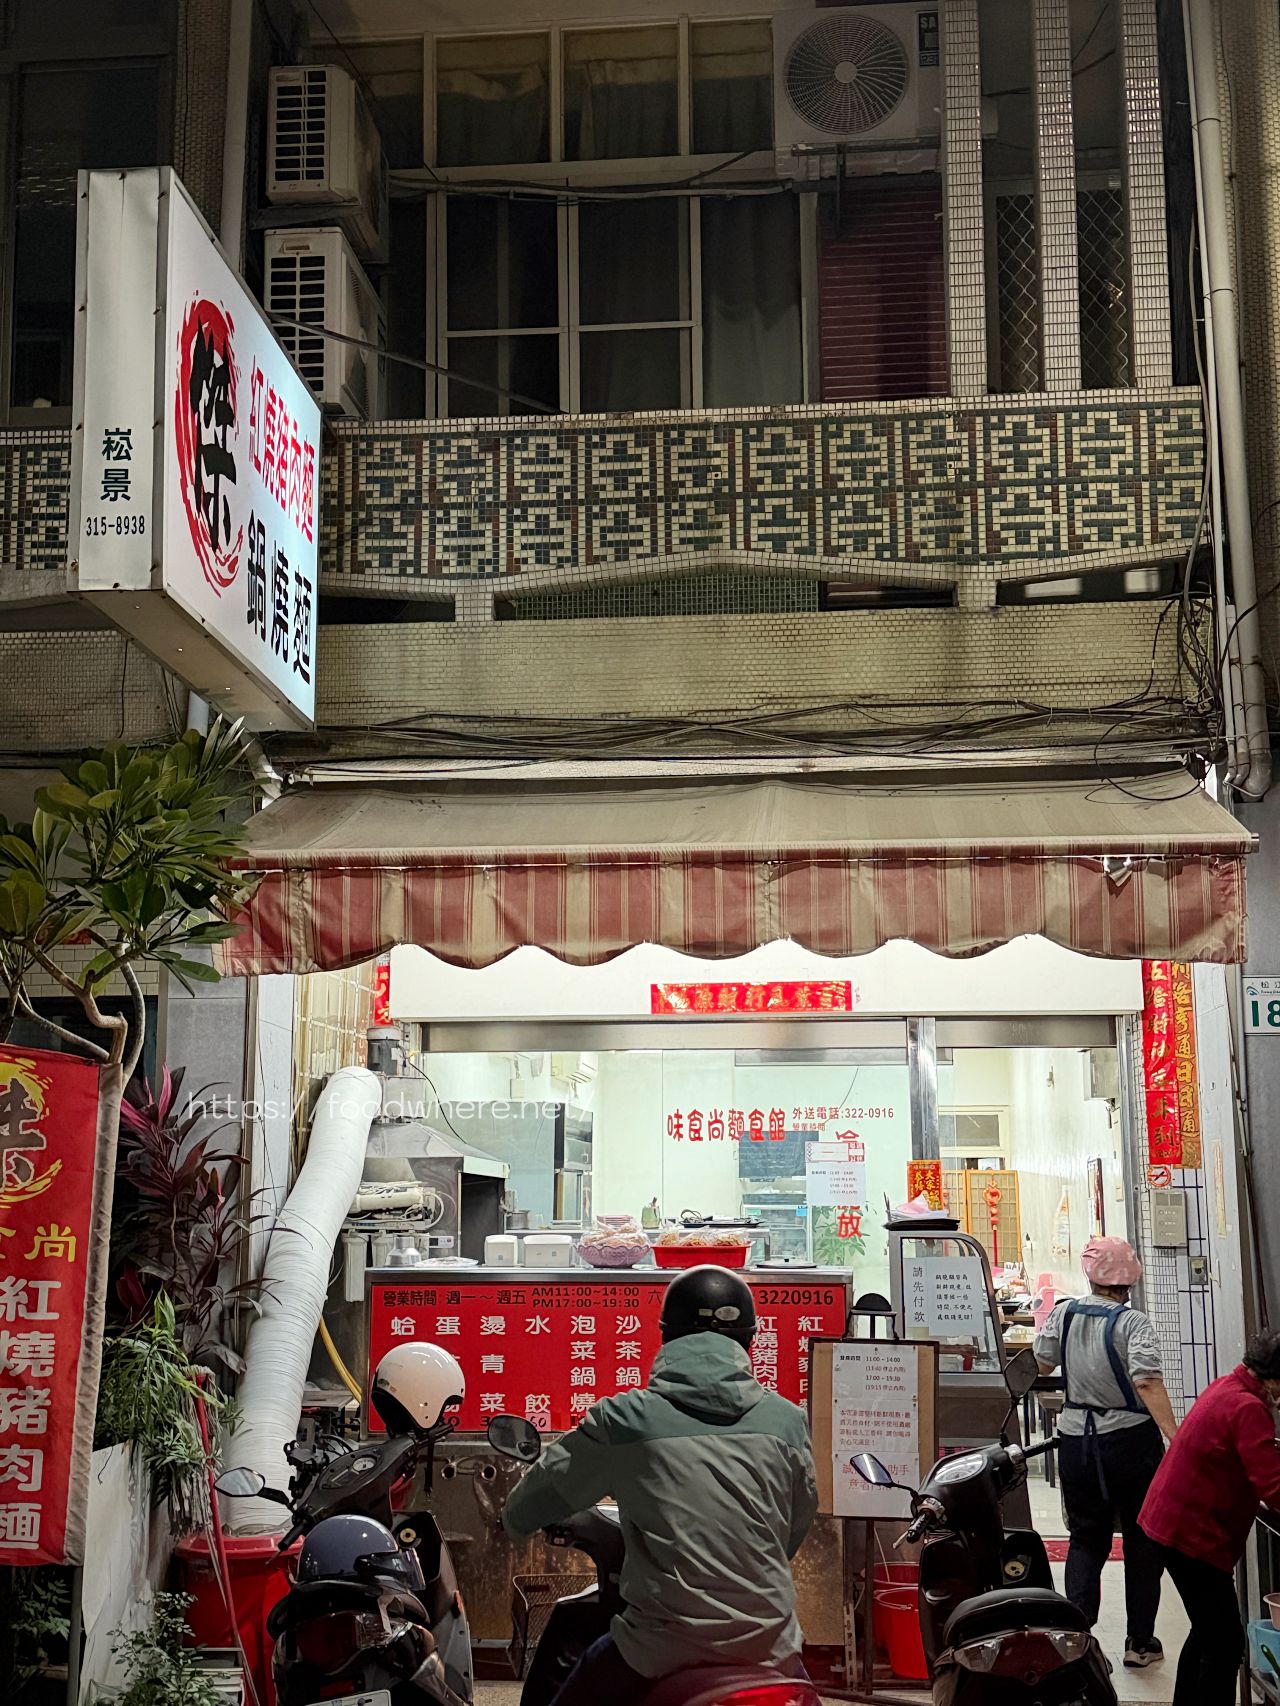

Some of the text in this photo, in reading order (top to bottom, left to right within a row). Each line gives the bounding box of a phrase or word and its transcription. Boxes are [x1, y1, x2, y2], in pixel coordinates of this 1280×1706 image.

[86, 515, 145, 537] 315-8938
[247, 509, 312, 686] 鍋燒麵
[667, 1107, 786, 1142] 味食尚麵食館
[383, 1290, 437, 1307] 營業時間
[758, 1289, 834, 1305] 3220916
[913, 1266, 925, 1323] 請先付款
[479, 1315, 506, 1413] 燙青菜
[615, 1314, 642, 1387] 沙茶鍋
